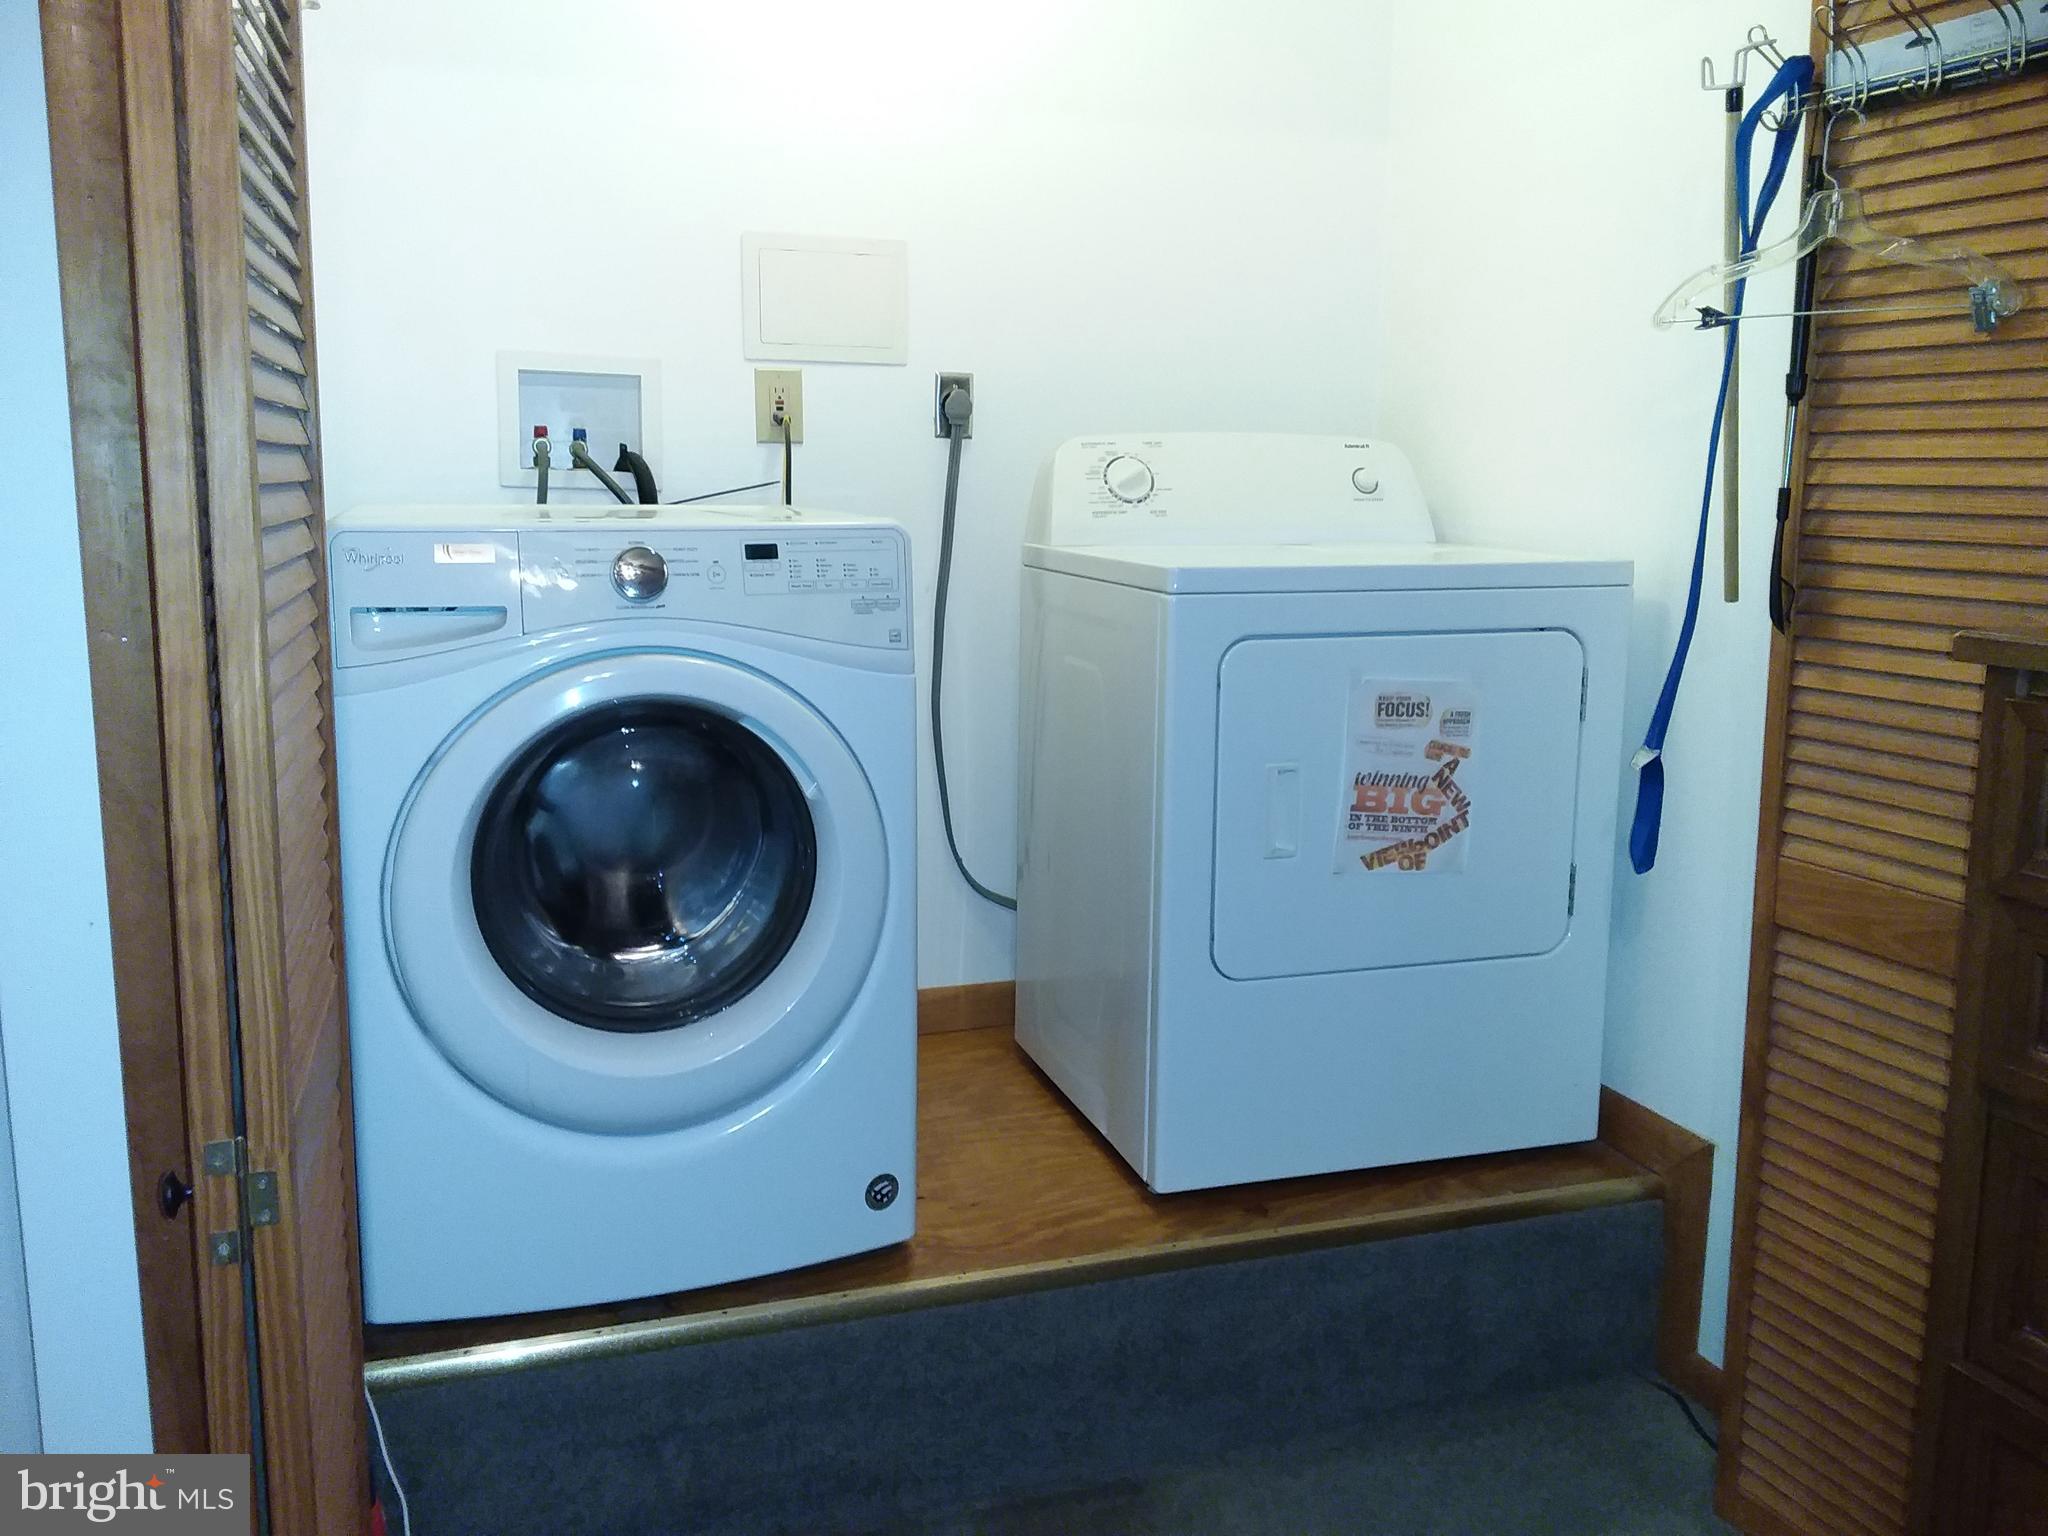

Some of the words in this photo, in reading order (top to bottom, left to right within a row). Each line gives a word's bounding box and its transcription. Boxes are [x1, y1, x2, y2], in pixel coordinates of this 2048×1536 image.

[343, 550, 405, 571] Whirlpool
[1377, 701, 1430, 718] FOCUS!
[1354, 770, 1430, 794] winning
[1350, 785, 1446, 816] BIG
[1348, 822, 1364, 830] OF
[1365, 823, 1389, 832] THE
[1391, 824, 1429, 833] NINTH
[1364, 815, 1388, 823] THE
[1390, 816, 1438, 825] BOTTOM
